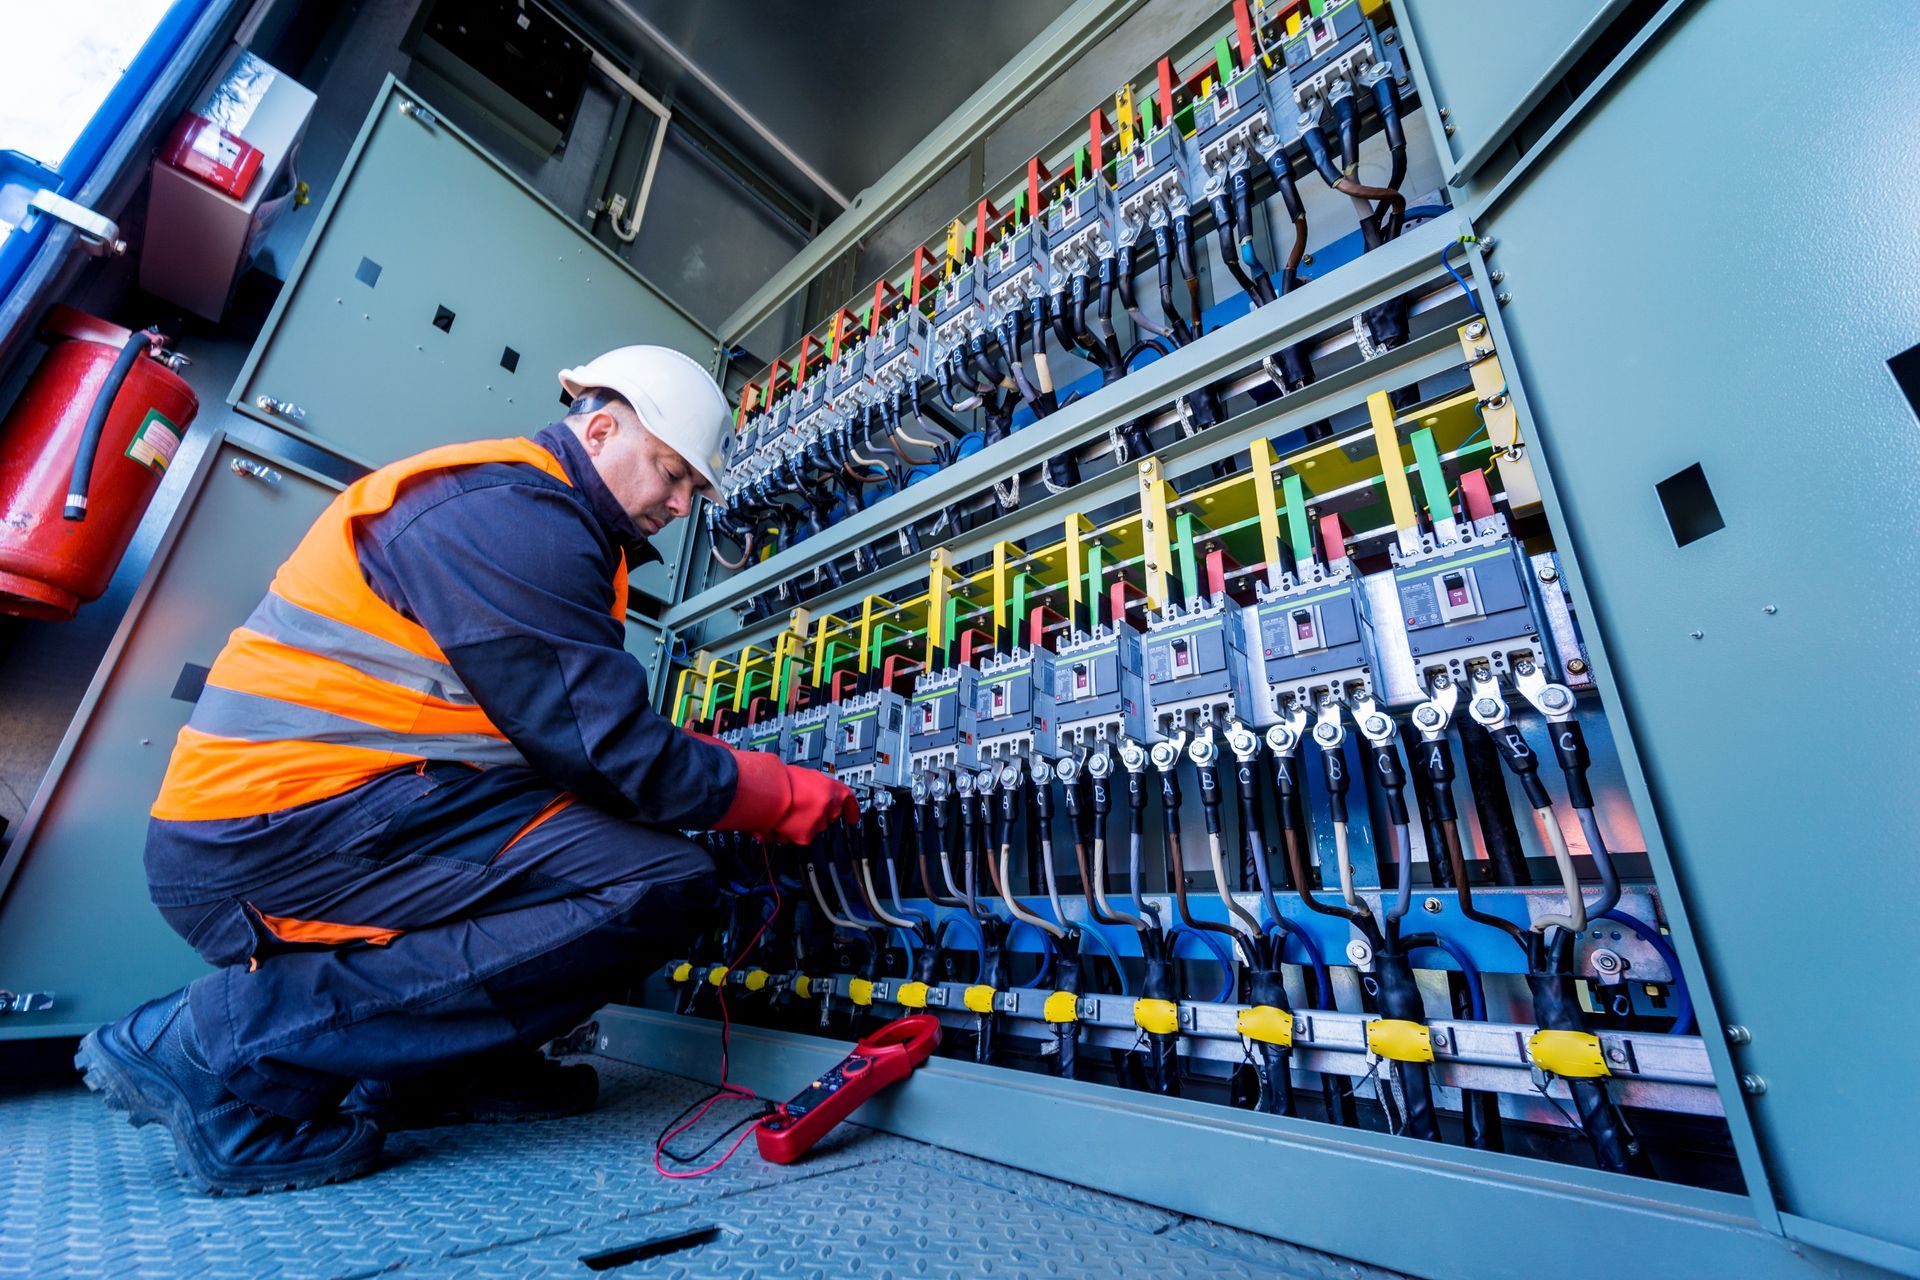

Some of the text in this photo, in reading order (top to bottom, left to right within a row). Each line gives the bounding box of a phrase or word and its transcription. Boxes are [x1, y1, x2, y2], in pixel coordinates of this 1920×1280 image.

[1274, 157, 1285, 168] C
[1234, 175, 1246, 190] B
[1215, 200, 1226, 218] A
[1175, 220, 1185, 233] C
[1155, 233, 1166, 248] B
[1118, 251, 1129, 266] A
[1098, 263, 1106, 278] C
[1073, 280, 1081, 296] B
[1030, 301, 1037, 314] C
[1050, 296, 1060, 311] A
[1007, 315, 1015, 329] B
[997, 328, 1005, 338] A
[971, 340, 980, 351] C
[953, 350, 962, 363] B
[937, 367, 946, 380] A
[1505, 734, 1530, 759] B
[1559, 732, 1577, 751] C
[1378, 753, 1392, 774] C
[1429, 746, 1444, 771] A
[1277, 763, 1292, 786] A
[1327, 755, 1342, 780] B
[1202, 772, 1215, 790] B
[1238, 767, 1250, 784] C
[1094, 785, 1106, 802] B
[1129, 779, 1138, 794] C
[1163, 777, 1173, 795] A
[1002, 795, 1010, 810] B
[1036, 791, 1044, 806] C
[1065, 788, 1075, 808] A
[914, 809, 919, 823] A
[934, 806, 940, 818] B
[961, 803, 967, 815] C
[981, 801, 987, 818] A
[877, 814, 885, 828] C
